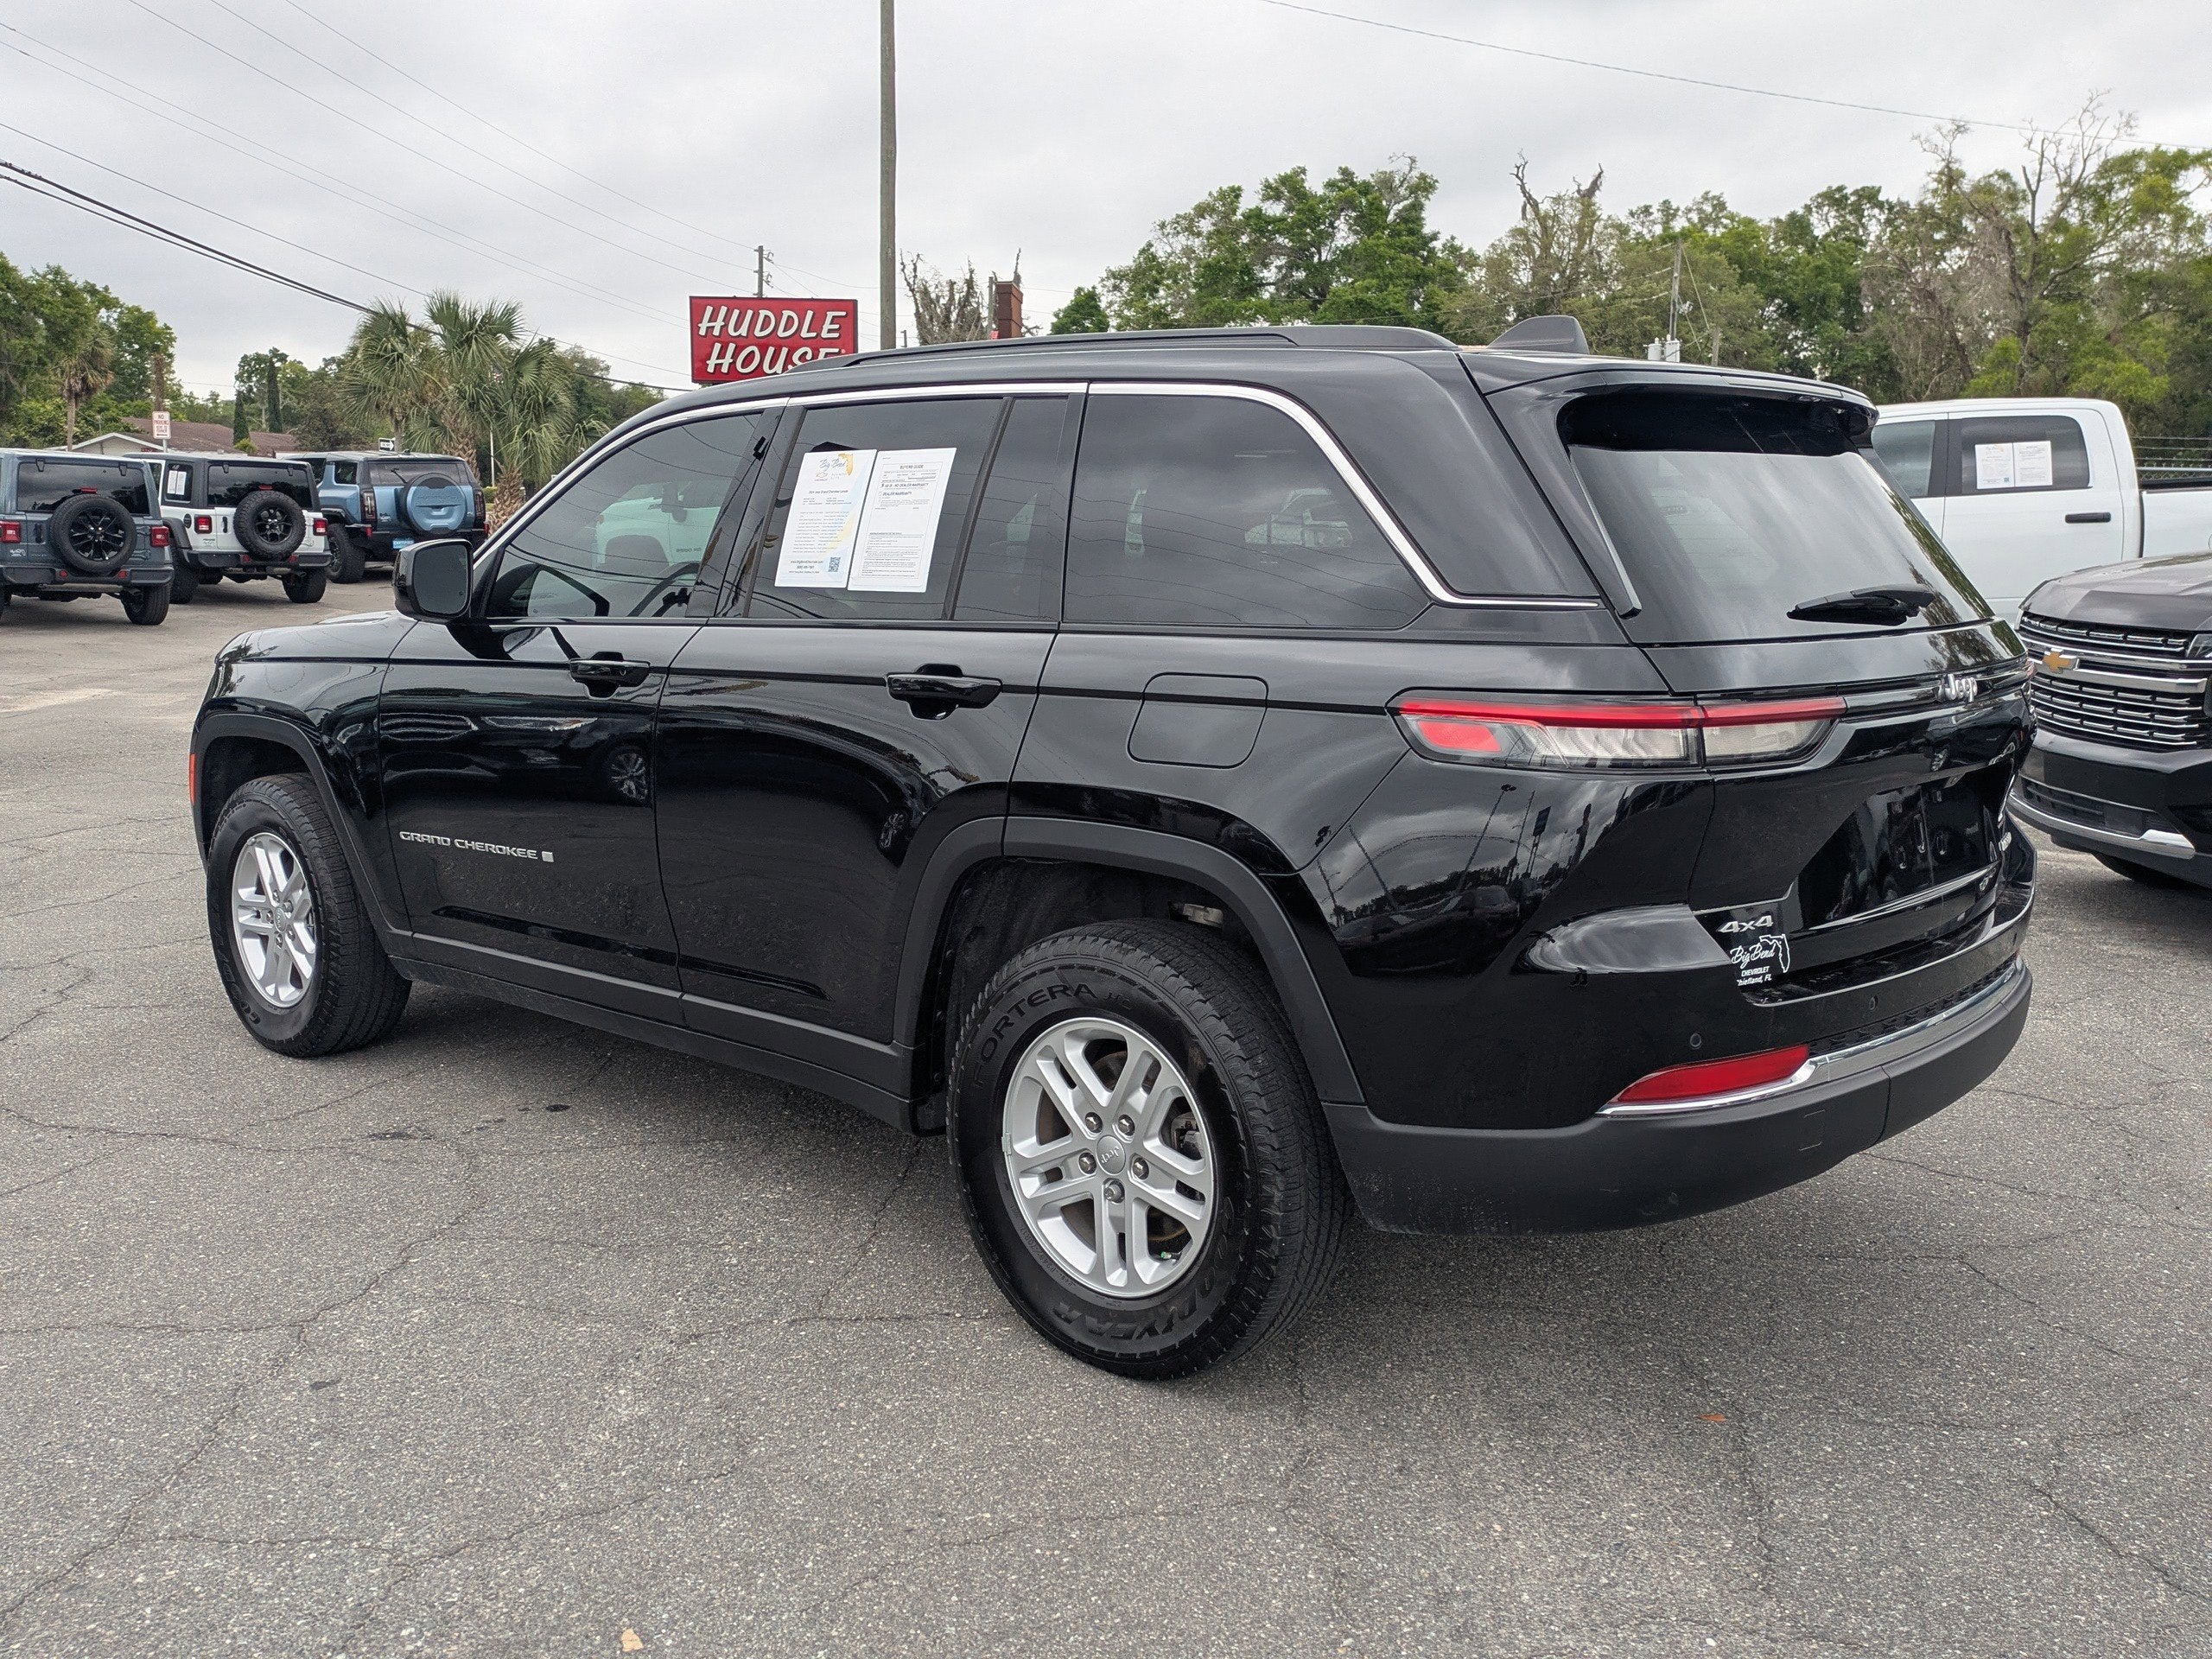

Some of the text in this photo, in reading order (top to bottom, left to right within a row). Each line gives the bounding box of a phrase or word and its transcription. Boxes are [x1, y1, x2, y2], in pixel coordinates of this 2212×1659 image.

[697, 305, 847, 339] HUDDLE
[1945, 673, 1978, 702] Jeep
[399, 831, 538, 860] GRAND CHEROKEE
[1717, 914, 1774, 933] 4x4
[1730, 943, 1776, 969] Big Bend
[1741, 965, 1770, 977] CHEVROLET
[974, 982, 1098, 1088] FORTERA
